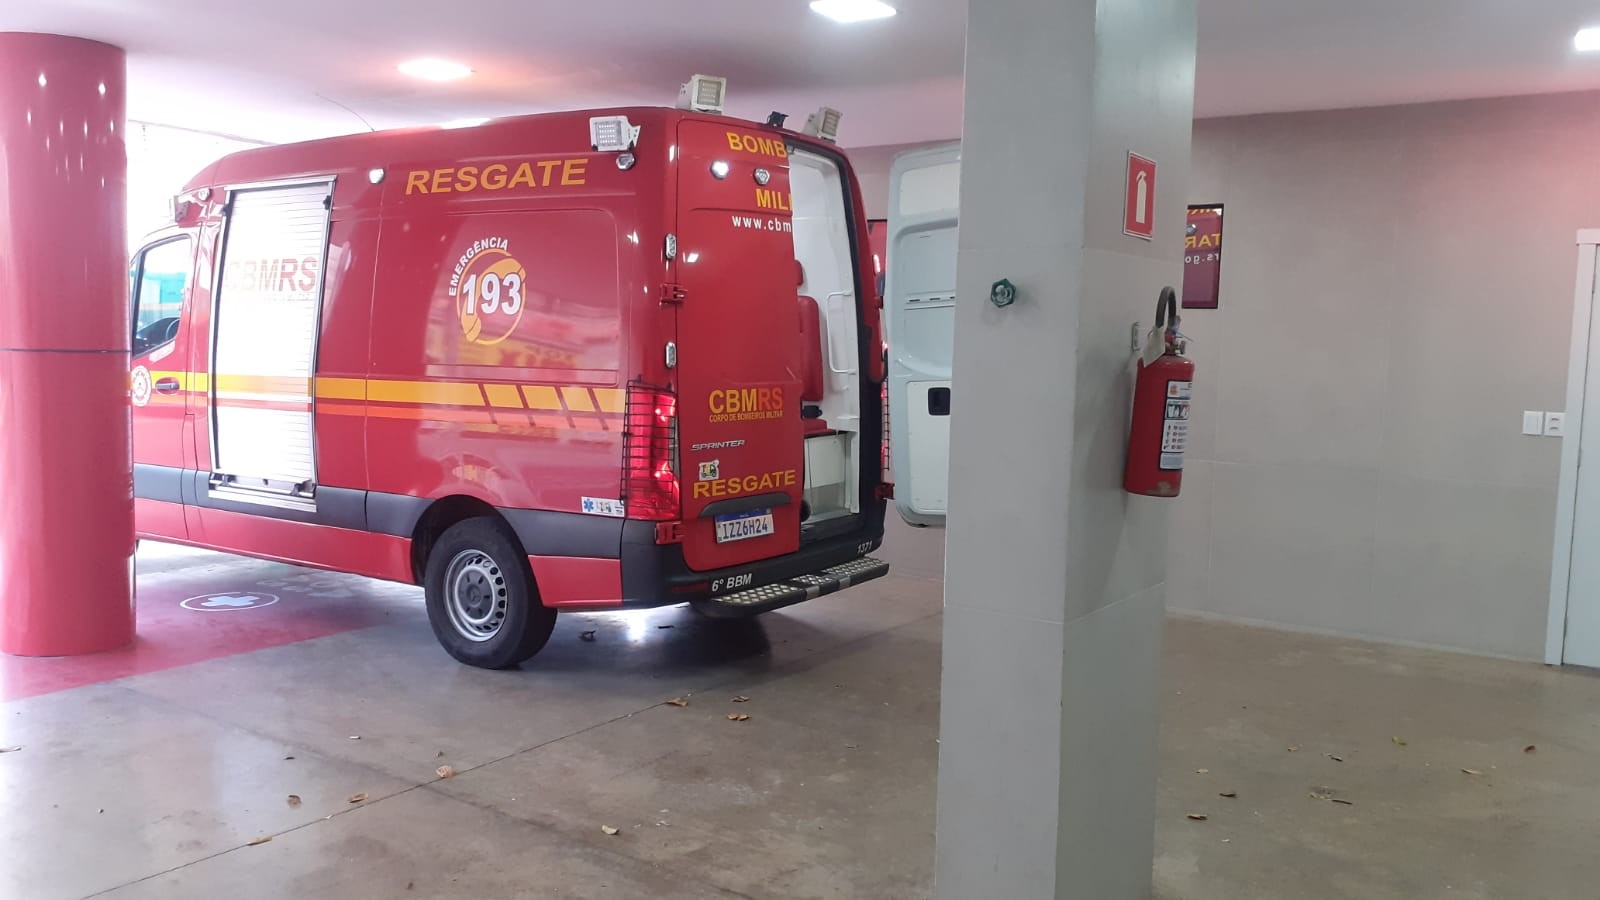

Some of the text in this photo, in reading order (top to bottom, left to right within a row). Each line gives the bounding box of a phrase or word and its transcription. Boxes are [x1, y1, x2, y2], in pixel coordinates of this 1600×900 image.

[726, 132, 787, 158] BOMB
[405, 158, 588, 195] RESGATE
[732, 215, 792, 233] www.cbm
[448, 236, 509, 297] EMERGÊNCIA
[463, 273, 521, 315] 193
[709, 387, 783, 414] CBMRS
[709, 413, 729, 423] CORPO
[729, 413, 737, 421] DE
[691, 440, 745, 451] SPRINTER
[693, 470, 796, 498] RESGATE
[722, 520, 769, 540] IZZ6H24
[857, 540, 873, 554] 1371
[726, 573, 753, 589] BBM
